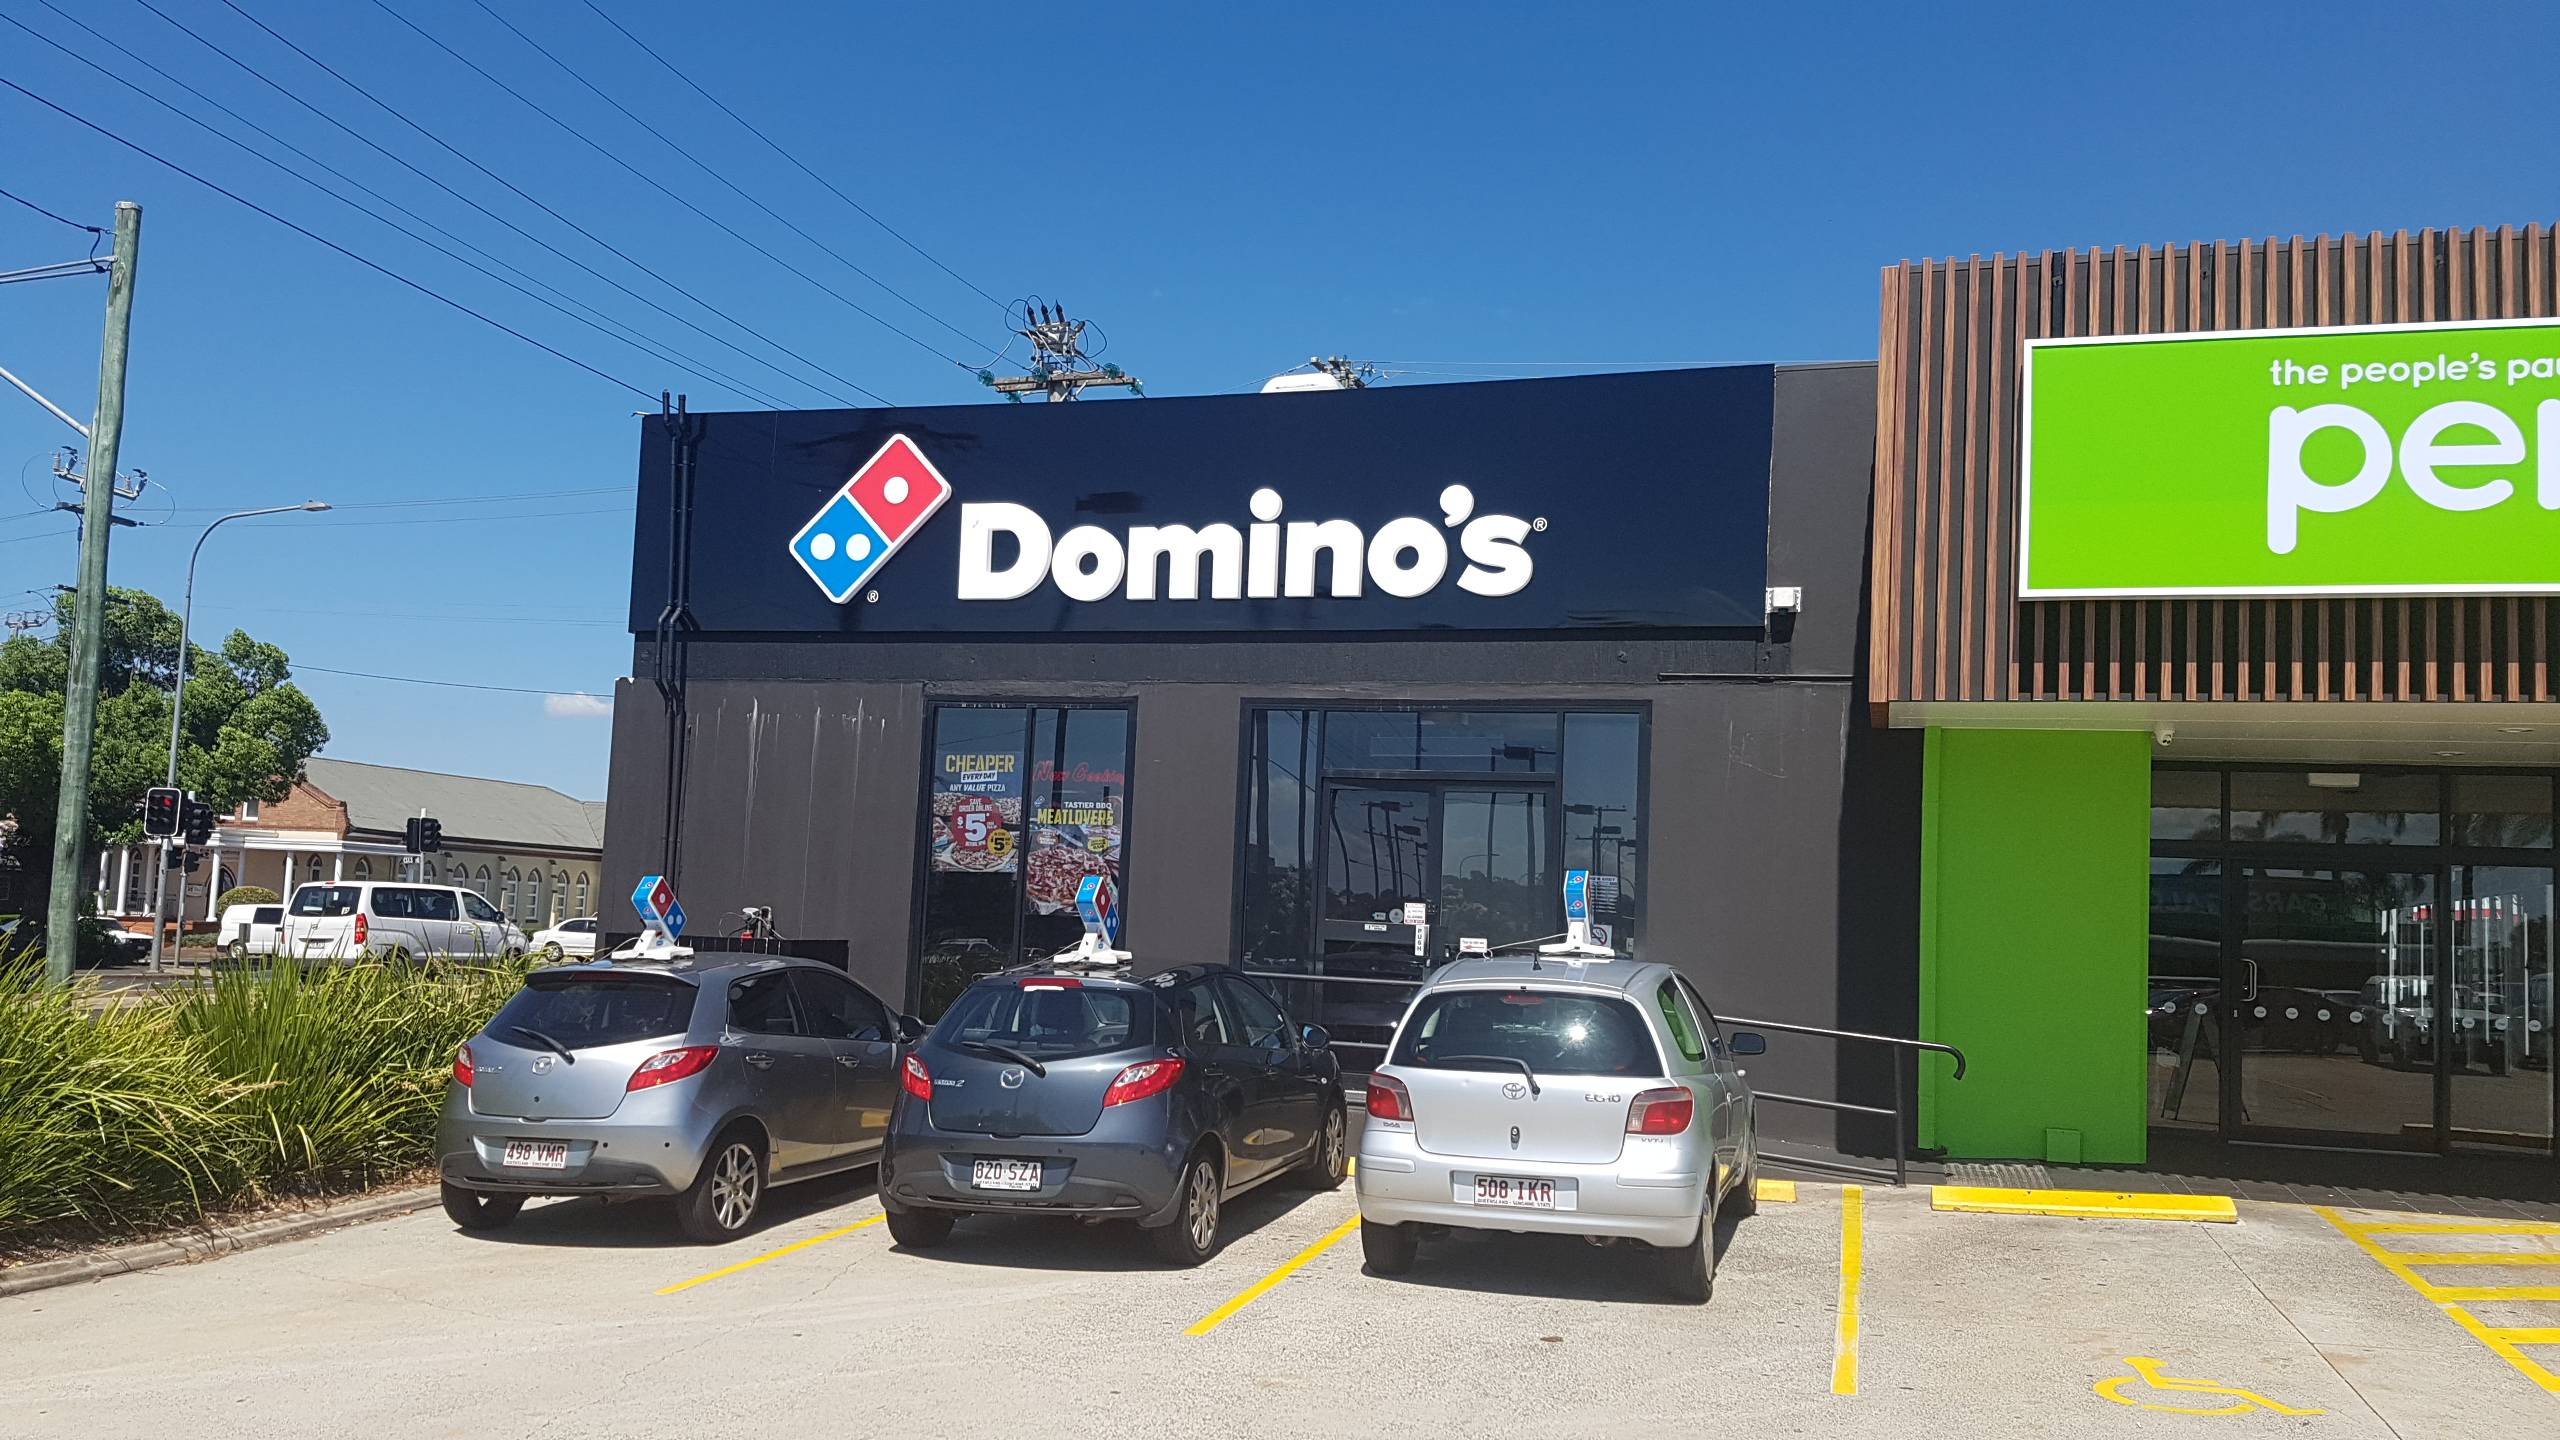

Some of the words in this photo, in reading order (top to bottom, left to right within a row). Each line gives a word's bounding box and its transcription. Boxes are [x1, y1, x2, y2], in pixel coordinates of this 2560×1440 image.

[2269, 359, 2329, 386] the
[2340, 352, 2497, 390] people’s
[2507, 357, 2560, 386] pa
[945, 754, 1015, 773] CHEAPER
[949, 784, 962, 792] ANY
[963, 783, 987, 792] VALUE
[987, 783, 1006, 792] PIZZA
[1064, 801, 1095, 809] TASTIER
[1037, 808, 1114, 826] MEATLOVERS
